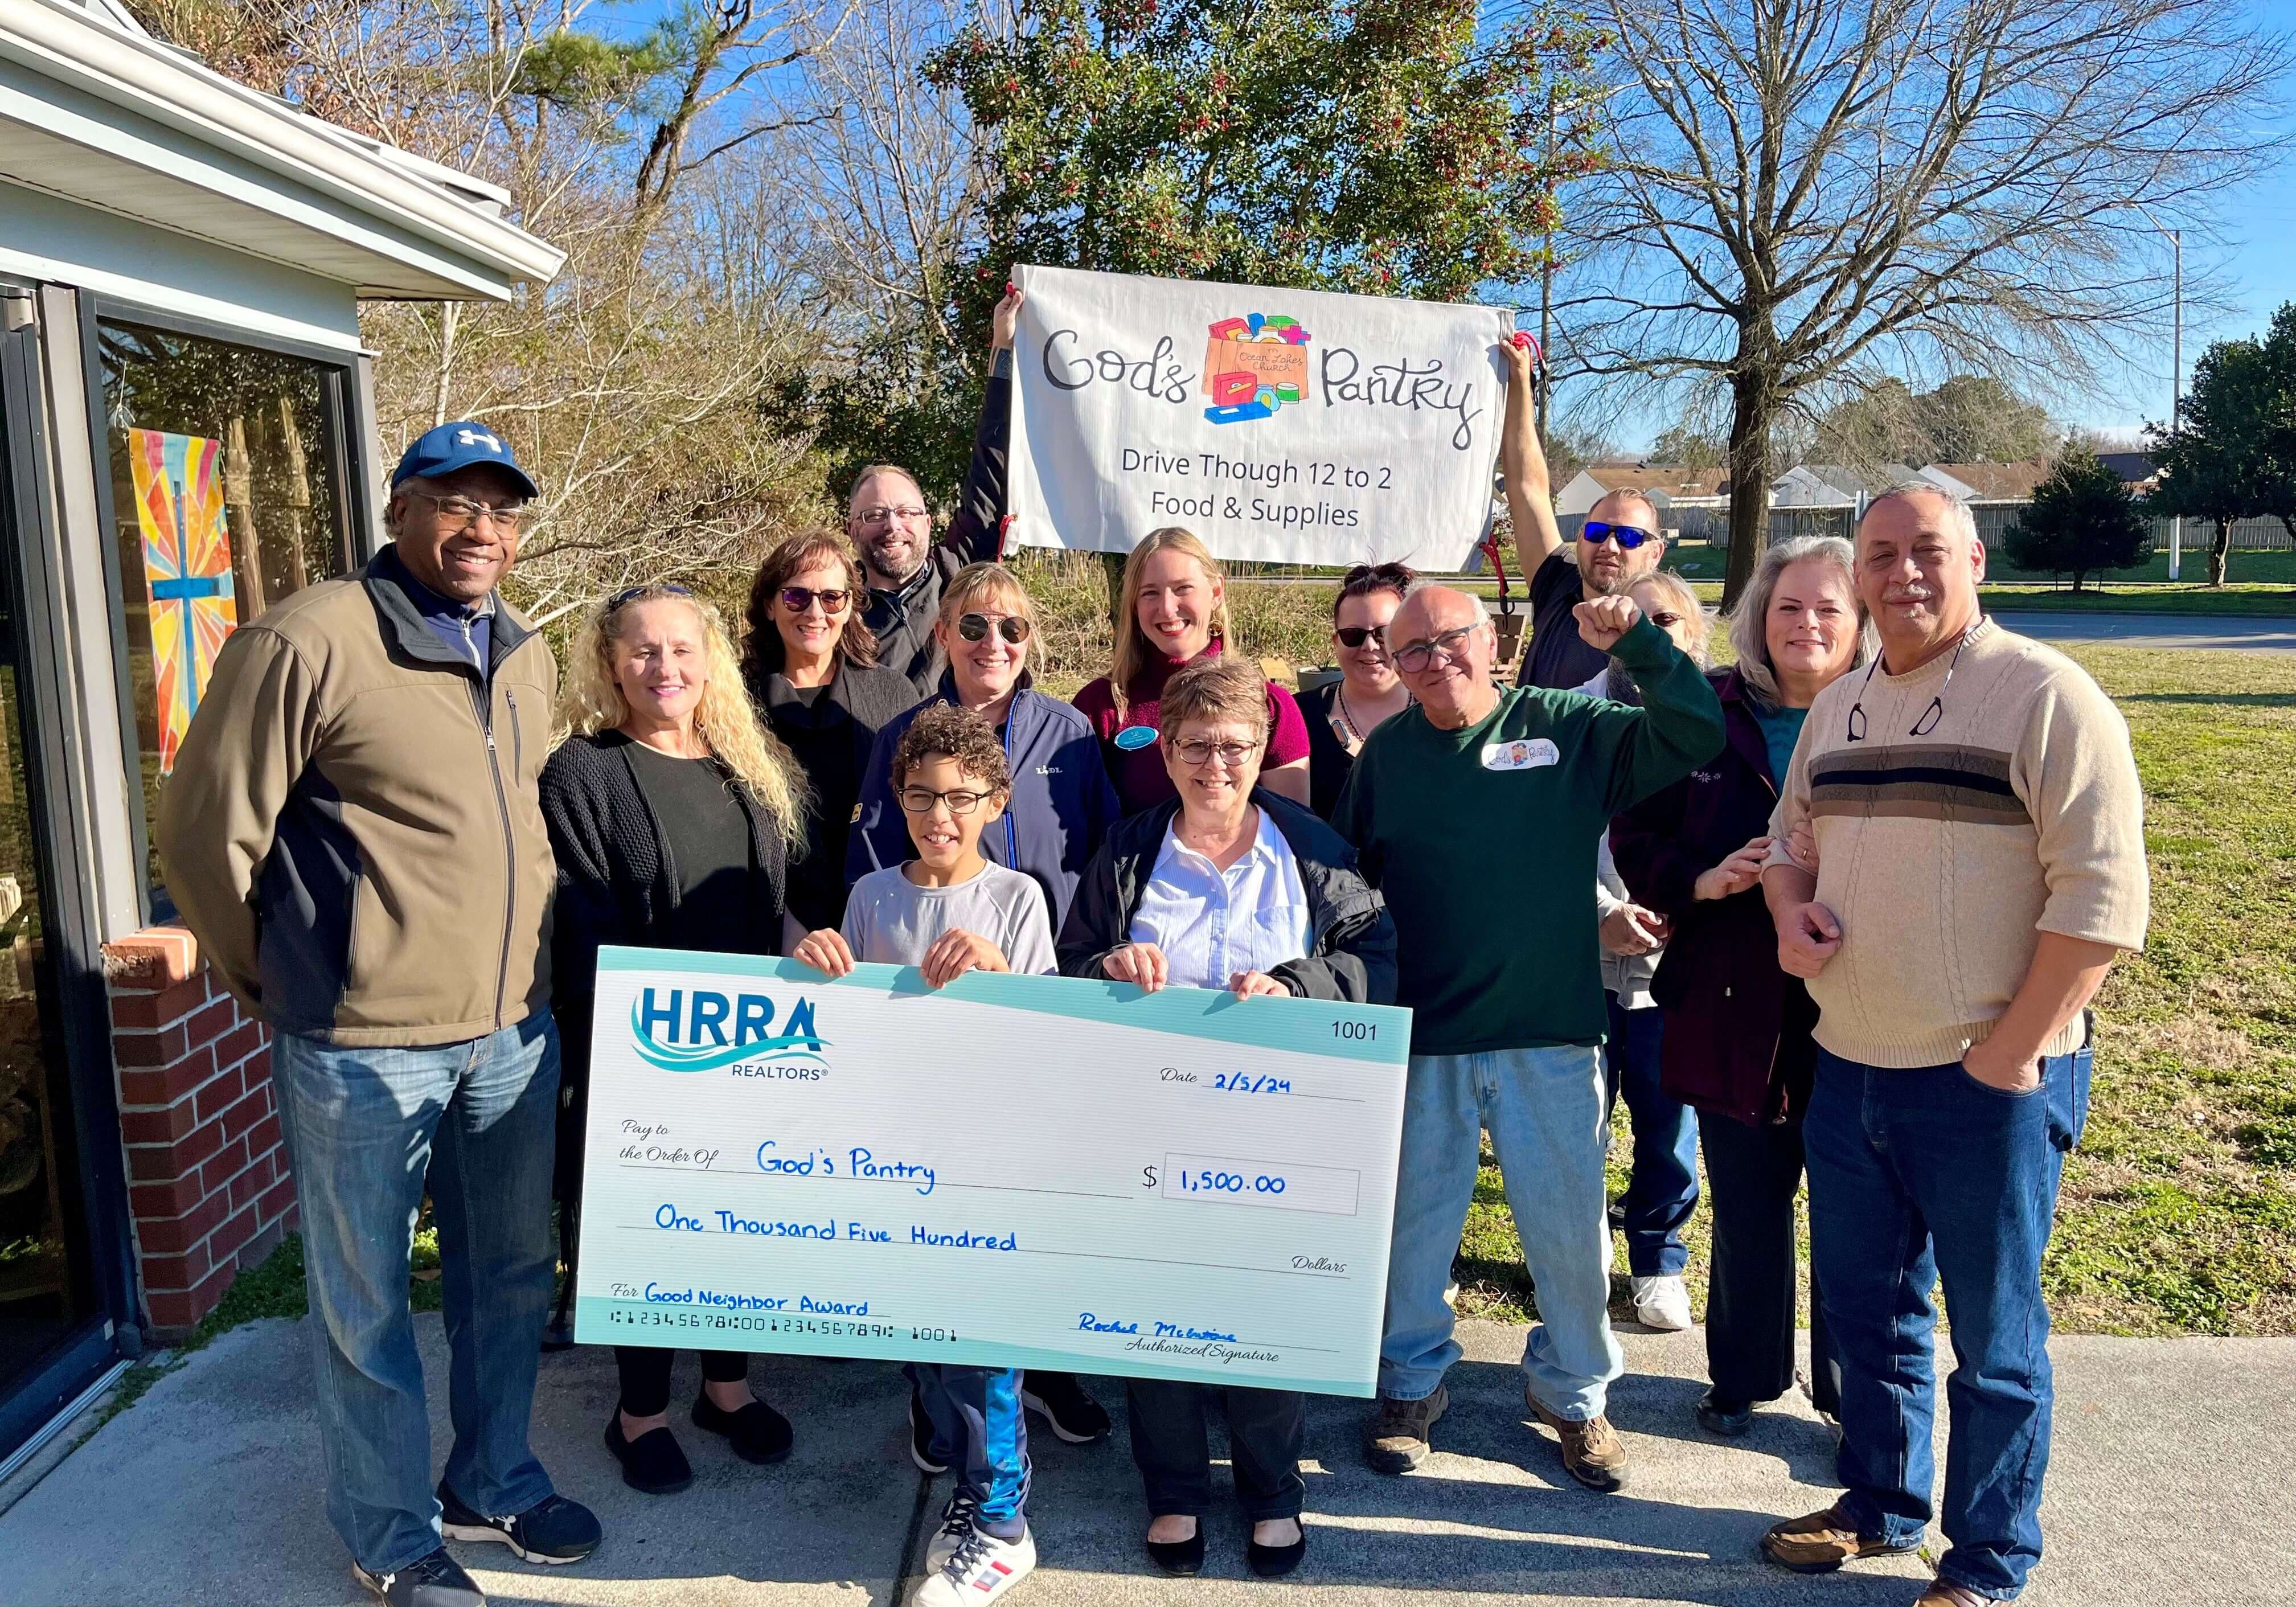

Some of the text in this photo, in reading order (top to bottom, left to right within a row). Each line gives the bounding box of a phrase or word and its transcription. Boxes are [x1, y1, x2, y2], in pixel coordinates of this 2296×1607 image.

[1240, 352, 1303, 366] Ocean Lakes
[1253, 361, 1293, 372] Church
[1043, 329, 1483, 450] God's Pantry
[1122, 448, 1392, 489] Drive Though 12 to 2
[1151, 491, 1359, 530] Food & Supplies
[641, 987, 822, 1052] HRRA
[1331, 1020, 1377, 1041] 1001
[1161, 1067, 1198, 1084] Date
[1215, 1072, 1291, 1093] 2/5/24
[621, 1120, 670, 1141] Pay to
[619, 1146, 719, 1166] the Order Of
[757, 1140, 936, 1195] God's Pantry
[1142, 1165, 1158, 1188] $
[1182, 1171, 1285, 1194] 1,500.00
[655, 1204, 1017, 1251] One Thousand Five Hundred
[1292, 1256, 1347, 1273] Dollars
[611, 1283, 638, 1298] For
[645, 1282, 868, 1317] Good Neighbor Award
[1125, 1338, 1280, 1364] Authorized Signature
